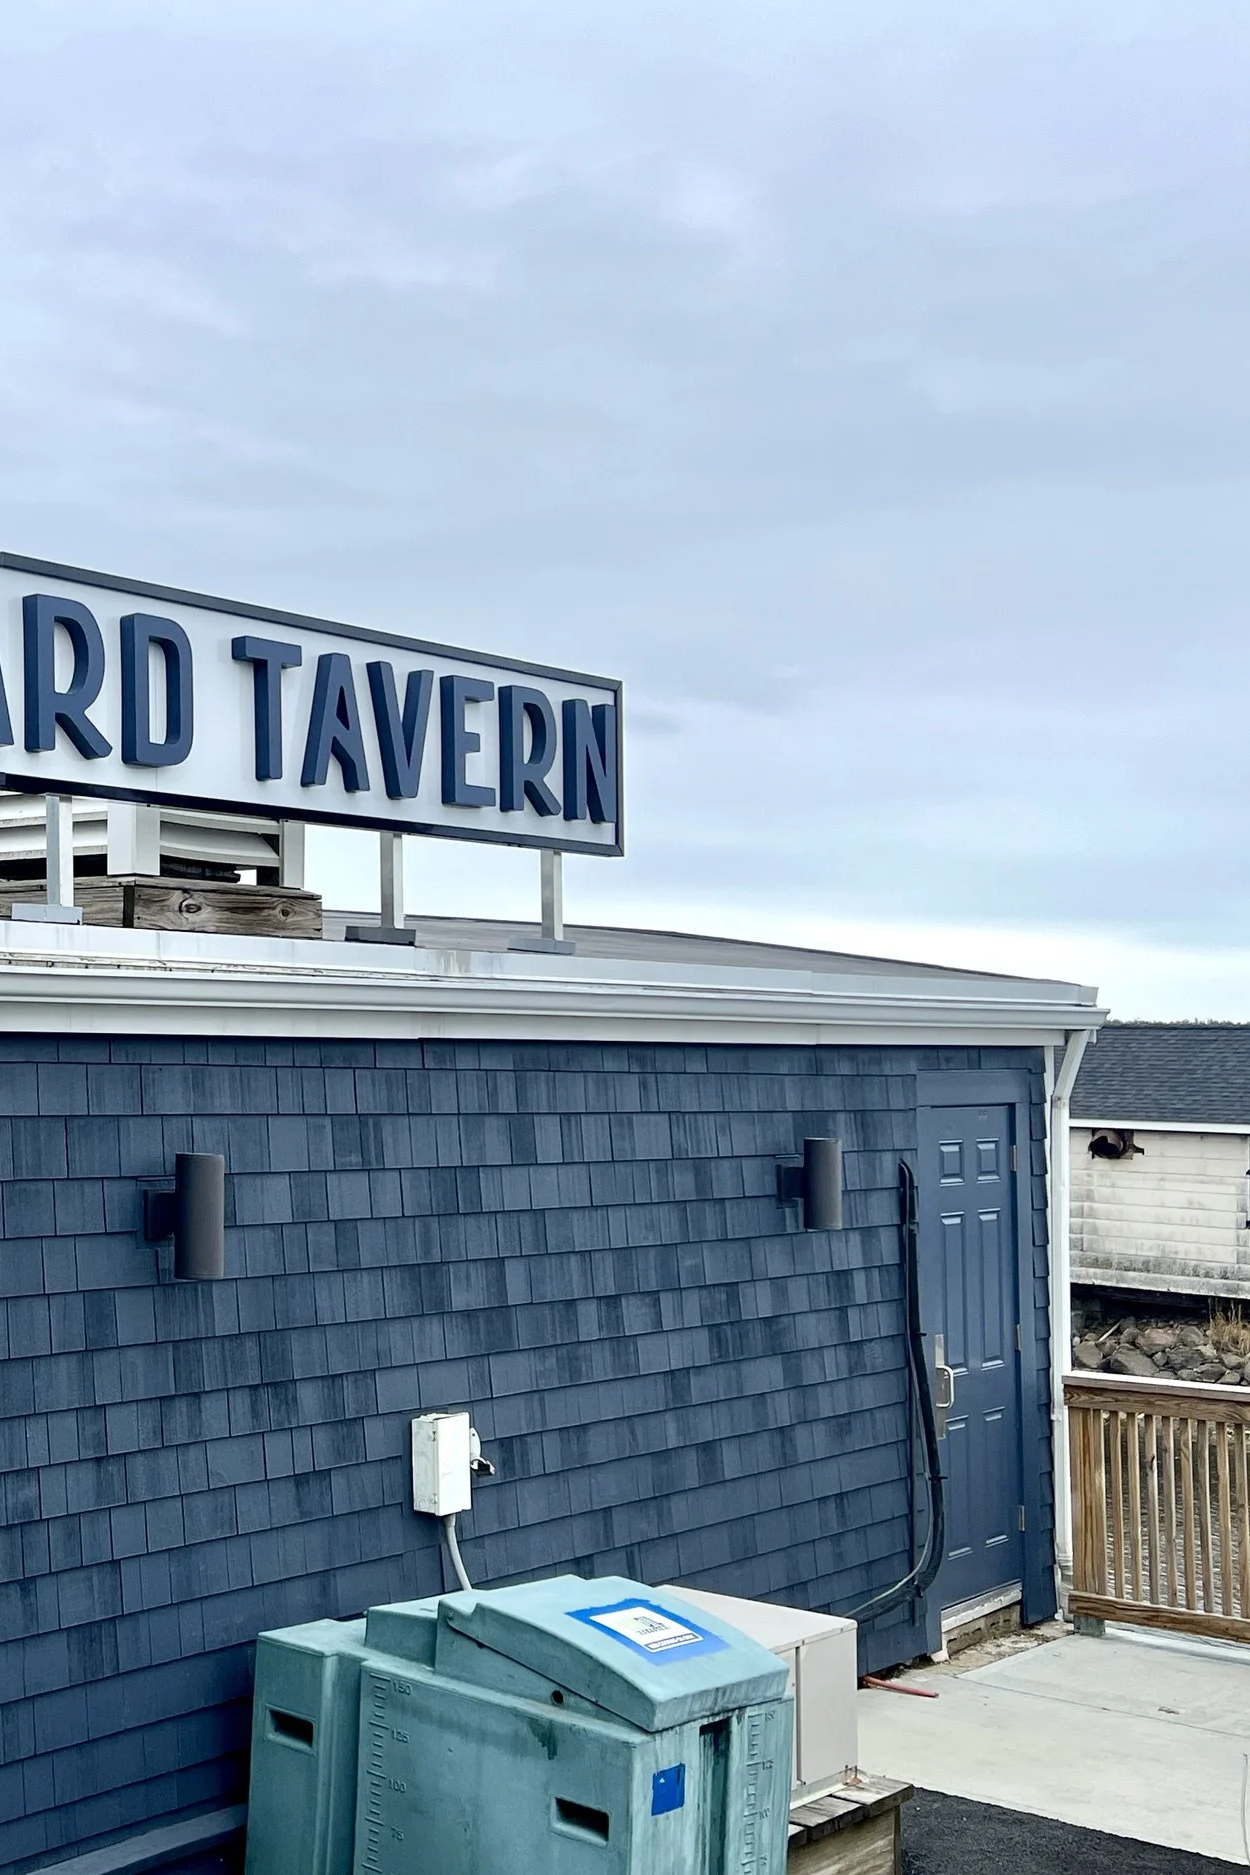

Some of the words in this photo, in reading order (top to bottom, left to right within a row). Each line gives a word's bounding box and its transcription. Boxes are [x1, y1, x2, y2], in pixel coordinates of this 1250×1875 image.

[231, 635, 616, 825] TAVERN
[392, 1681, 413, 1696] 150
[391, 1728, 410, 1744] 125
[388, 1778, 407, 1794] 100
